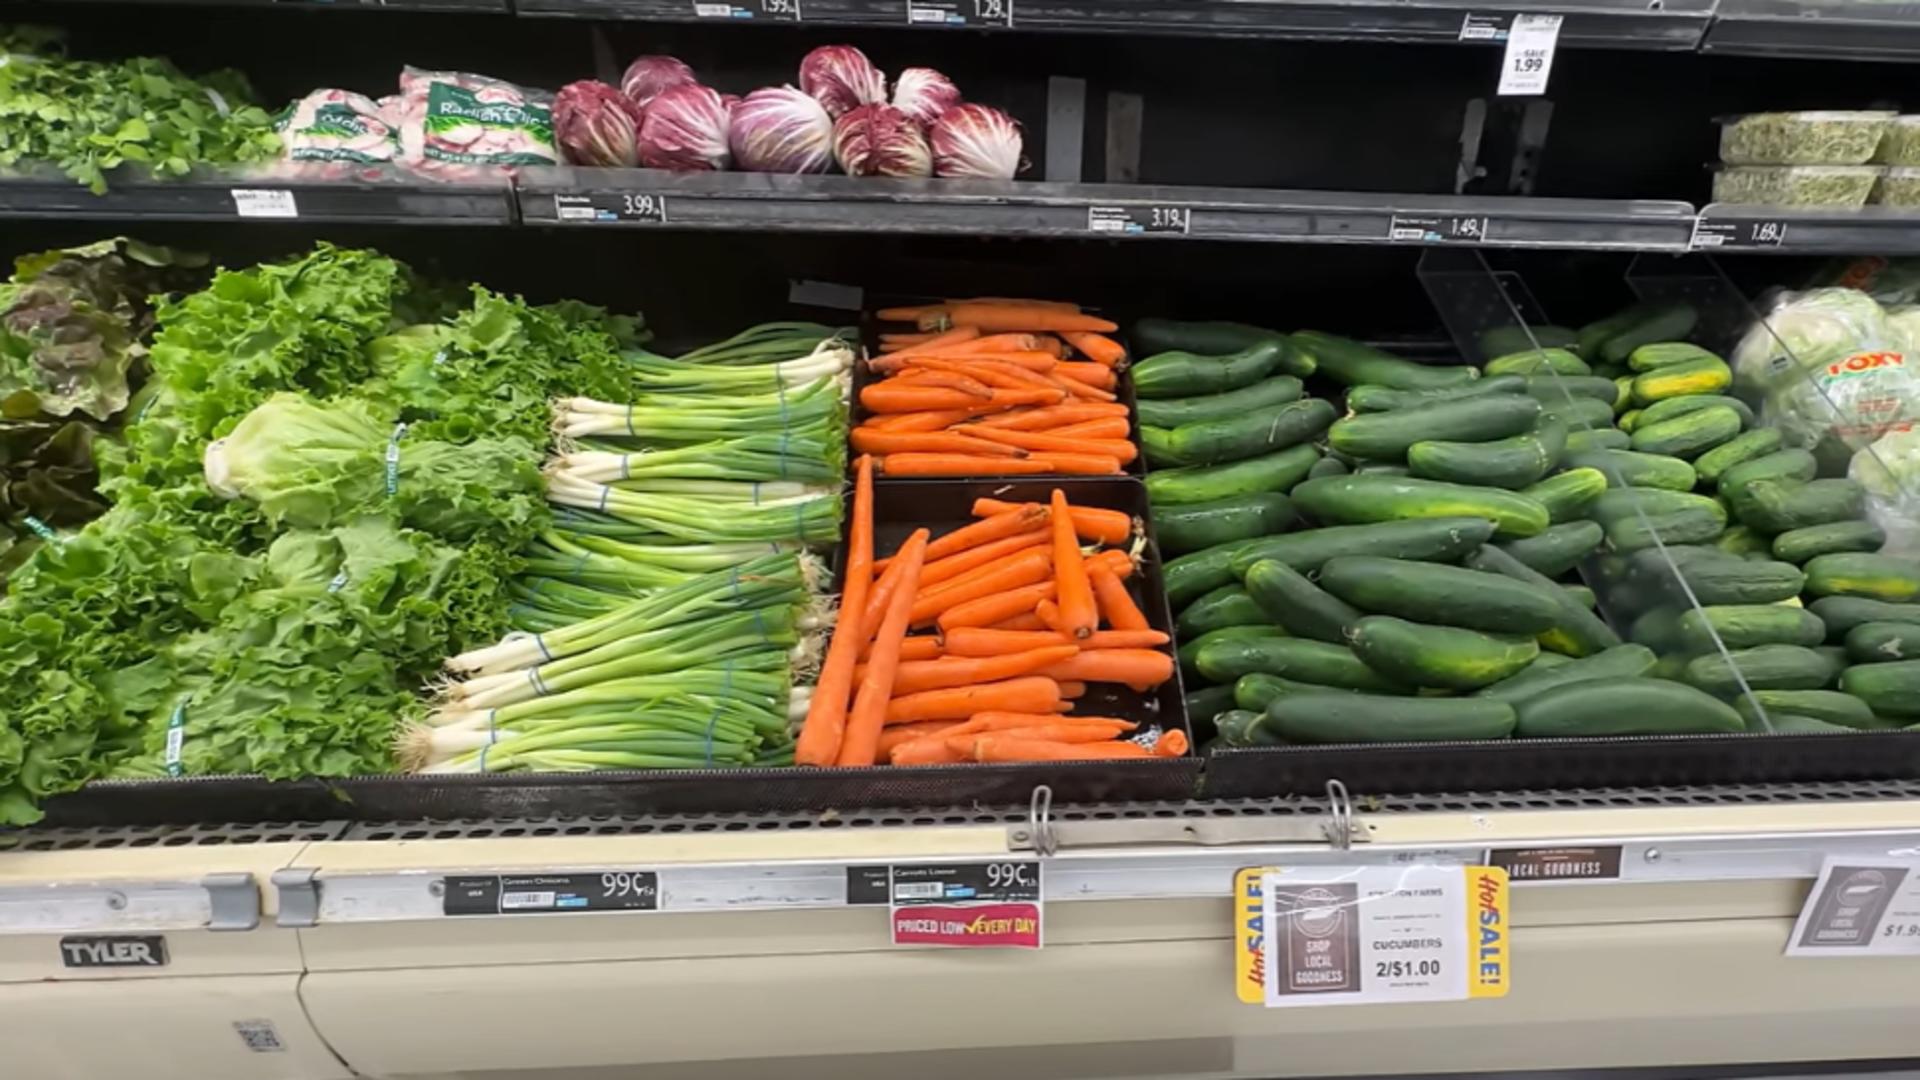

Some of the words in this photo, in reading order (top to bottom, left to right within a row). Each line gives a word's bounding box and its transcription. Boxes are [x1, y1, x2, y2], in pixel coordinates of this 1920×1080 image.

[975, 0, 1002, 18] 1.29
[1514, 59, 1543, 72] 1.99
[624, 195, 653, 215] 3.99
[1152, 207, 1179, 227] 3.19
[1452, 218, 1477, 236] 1.49
[1752, 223, 1777, 241] 1.69
[987, 863, 1027, 887] 99¢
[1543, 862, 1600, 877] GOODNESS
[601, 872, 643, 897] 99¢
[897, 918, 938, 934] PRICED
[939, 920, 965, 935] LOW
[975, 918, 1012, 934] EVERY
[1013, 918, 1036, 932] DAY
[63, 943, 158, 964] TYLER
[1306, 939, 1331, 954] SHOP
[1372, 938, 1443, 951] CUCUMBERS
[1480, 909, 1500, 985] SALE!
[1304, 955, 1333, 968] LOCAL
[1376, 959, 1440, 978] 2/$1.00
[1296, 970, 1343, 984] GOODNESS
